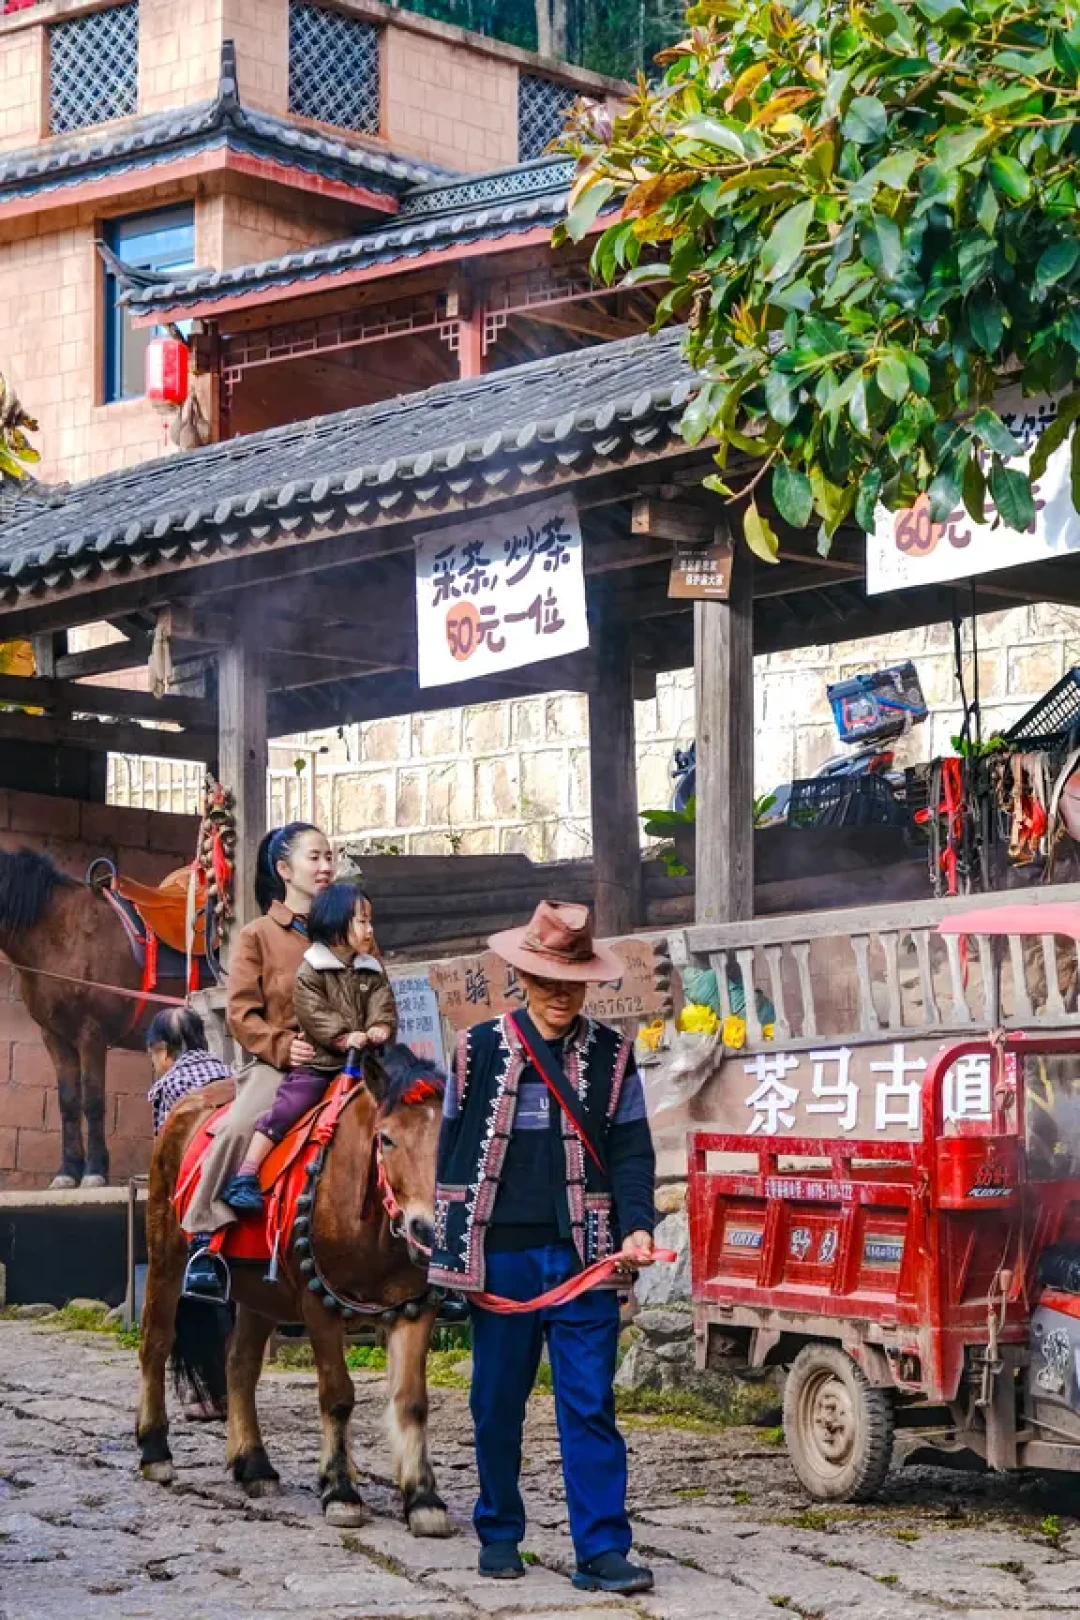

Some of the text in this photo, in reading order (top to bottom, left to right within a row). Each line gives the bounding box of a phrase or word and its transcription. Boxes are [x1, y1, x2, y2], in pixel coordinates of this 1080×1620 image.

[446, 586, 566, 656] 50元一位
[743, 1044, 992, 1135] 茶马古道
